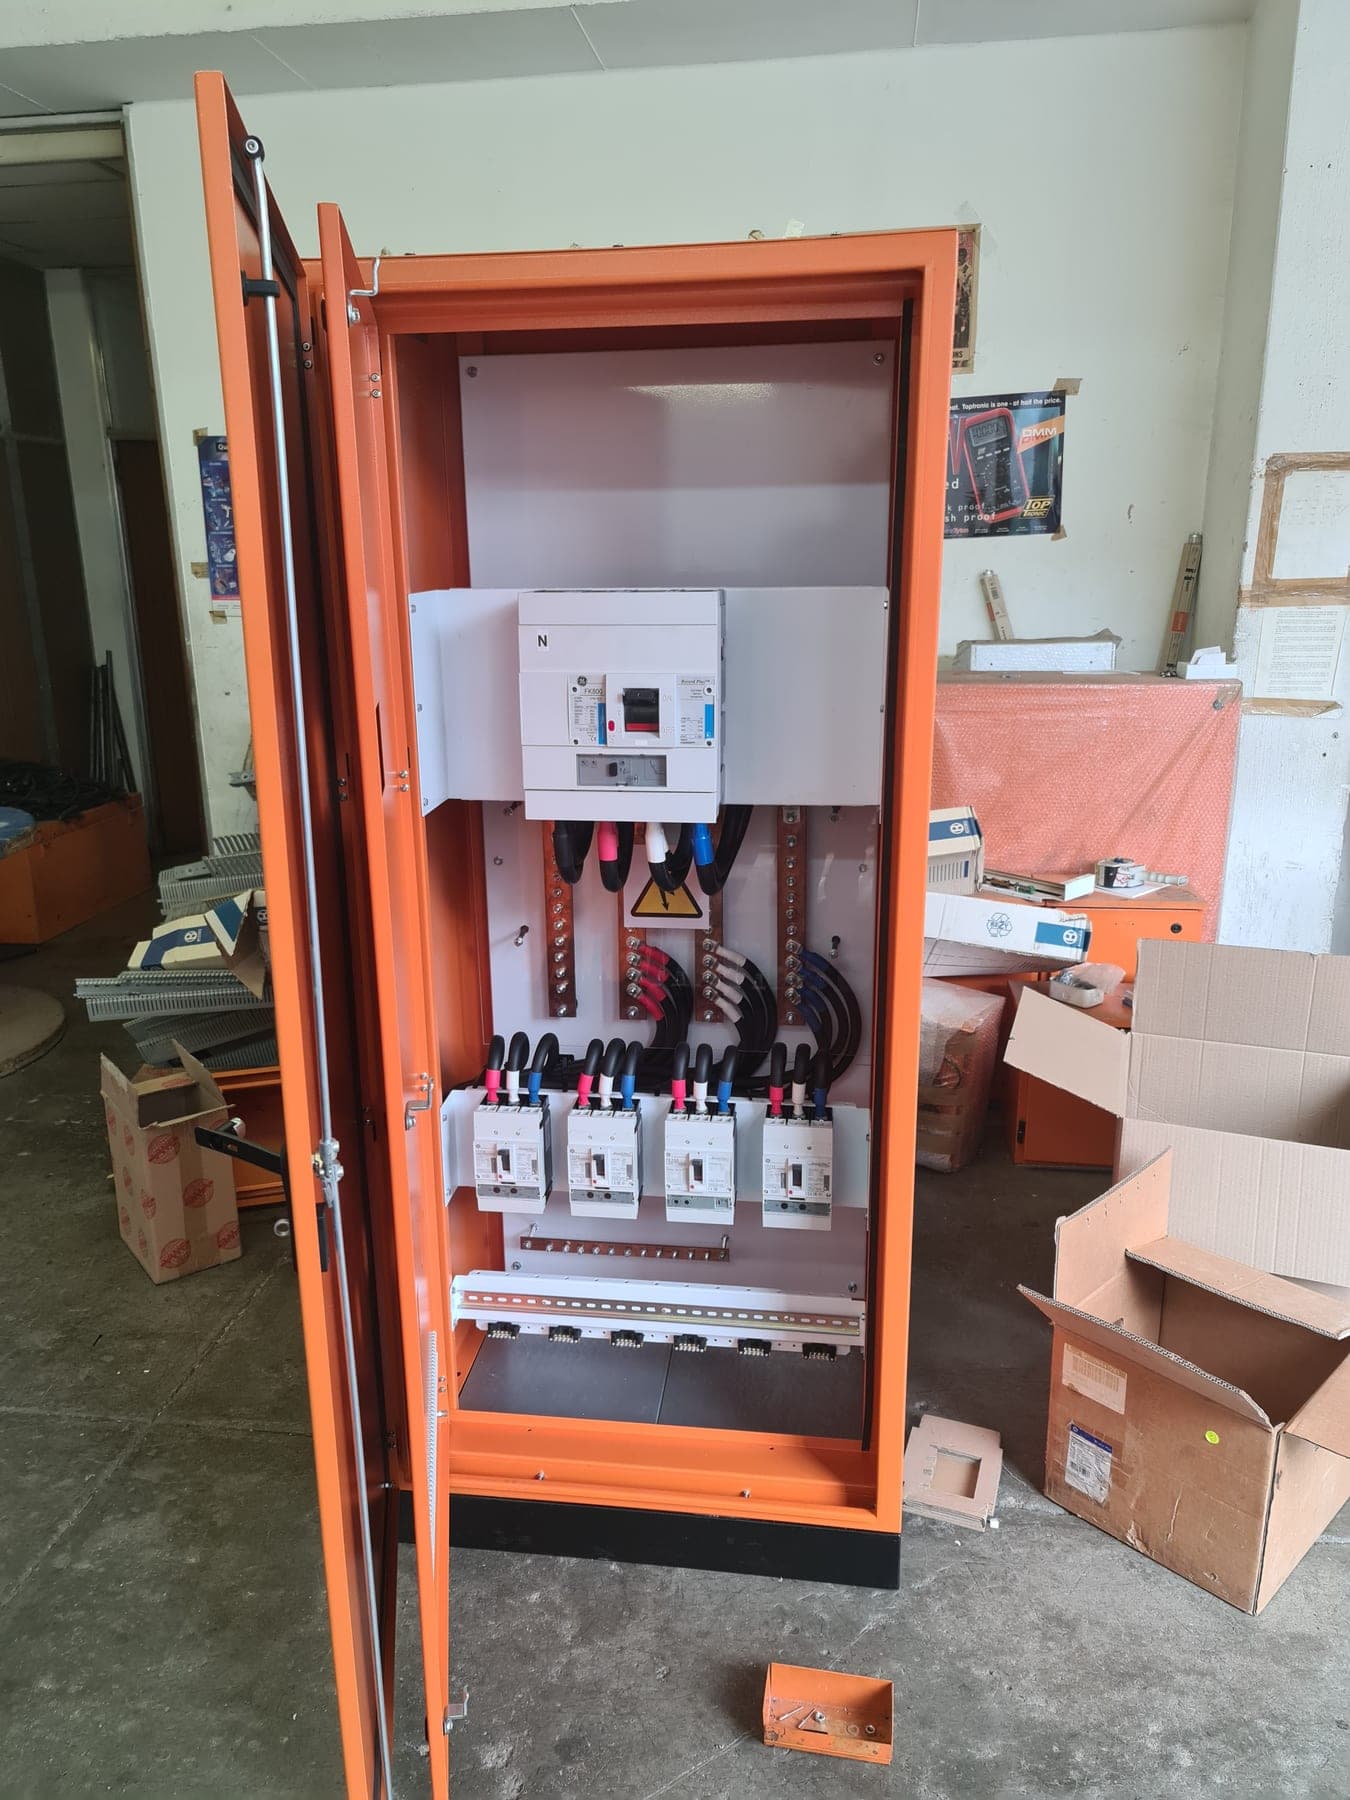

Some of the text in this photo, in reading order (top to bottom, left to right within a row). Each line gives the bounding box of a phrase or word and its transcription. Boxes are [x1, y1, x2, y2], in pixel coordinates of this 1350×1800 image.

[962, 402, 989, 410] Toptronic
[963, 511, 996, 523] proof
[538, 635, 548, 647] N
